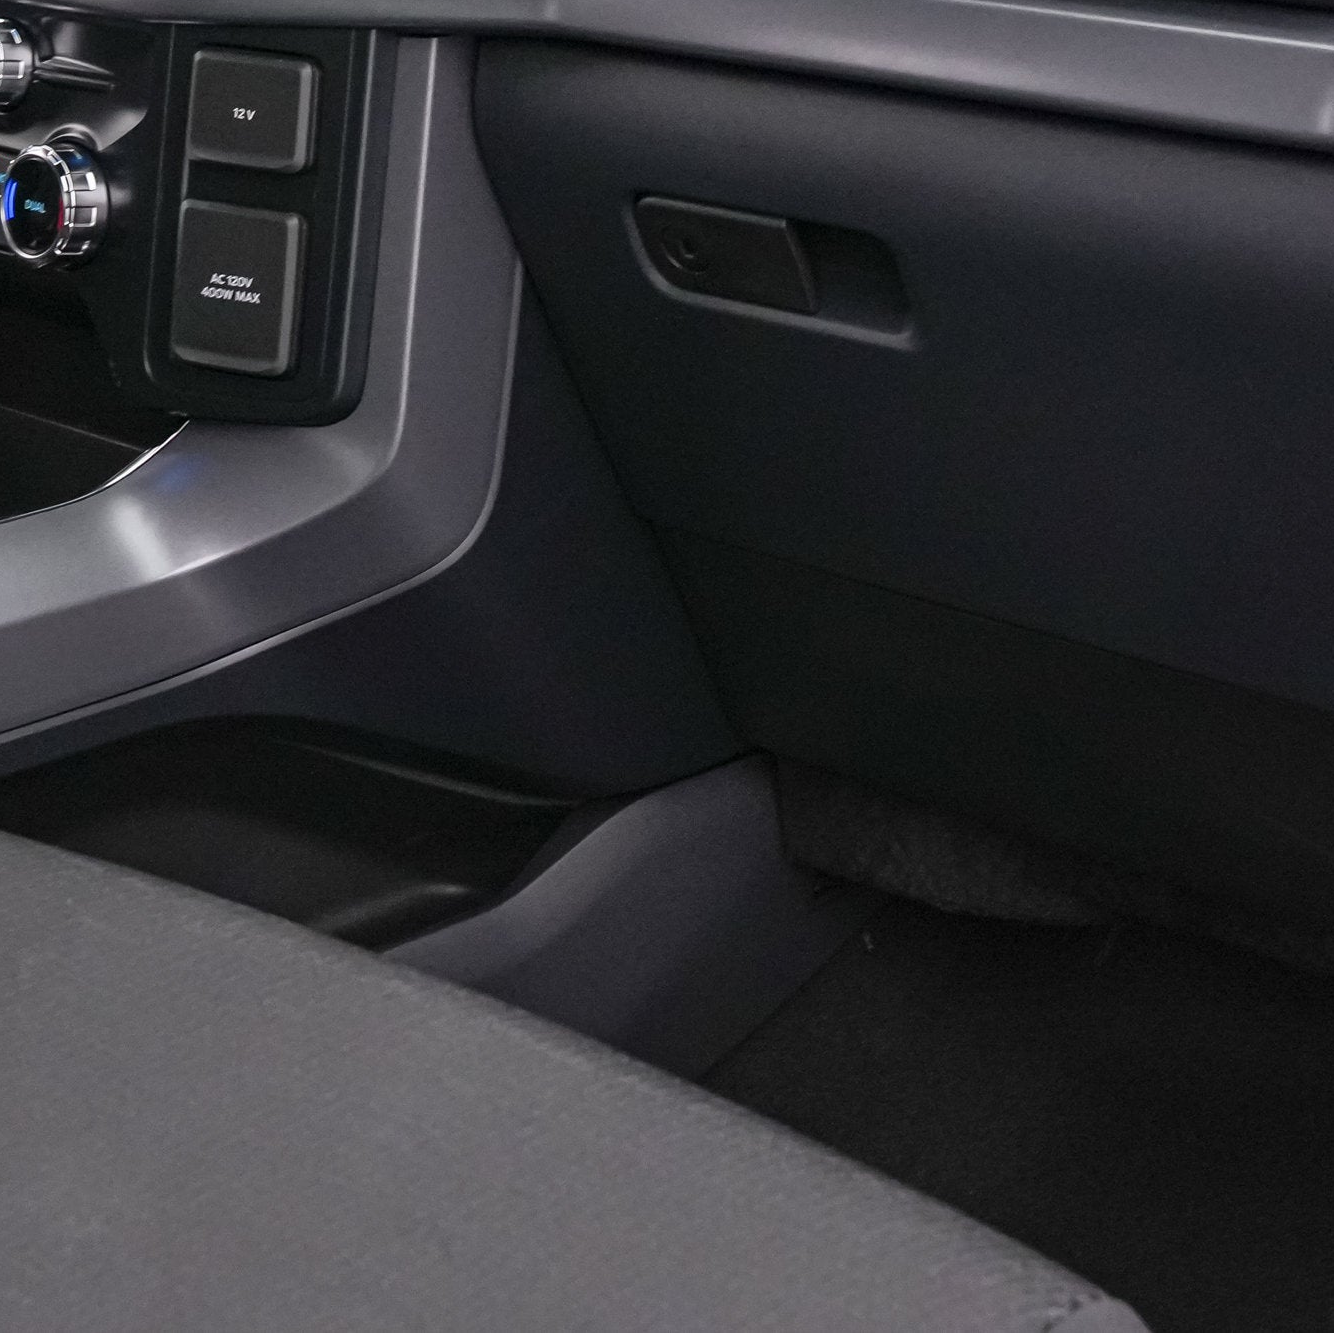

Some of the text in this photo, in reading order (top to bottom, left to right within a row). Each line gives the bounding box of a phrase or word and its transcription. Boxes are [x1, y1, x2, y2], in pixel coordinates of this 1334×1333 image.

[24, 198, 47, 214] DUAL
[209, 272, 254, 289] AC 120V
[200, 286, 261, 305] 400W MAX
